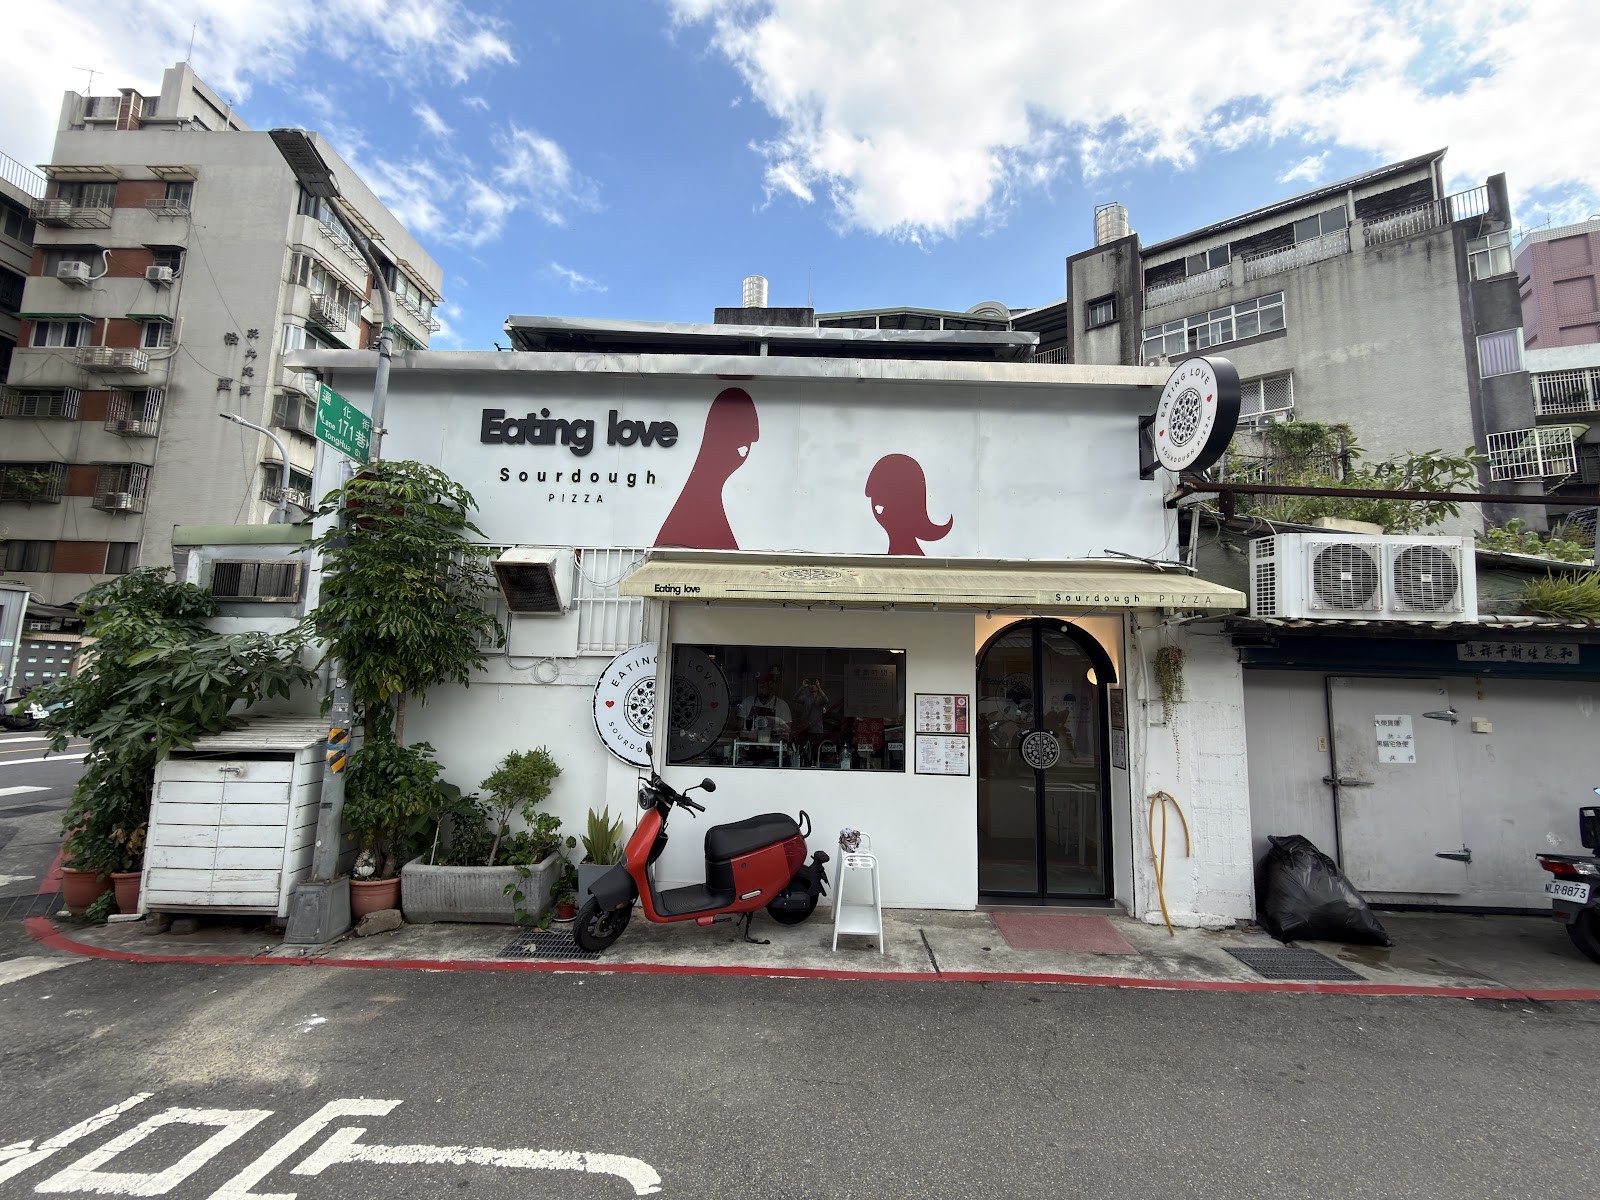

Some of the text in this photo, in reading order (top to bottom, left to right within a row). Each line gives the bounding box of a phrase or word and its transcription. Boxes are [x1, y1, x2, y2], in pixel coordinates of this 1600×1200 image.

[1160, 368, 1210, 418] EATING LOVE
[322, 389, 370, 432] 通化街
[321, 415, 336, 431] Lane
[480, 408, 679, 457] Eating love
[324, 429, 351, 452] TongHua
[1162, 415, 1211, 463] SOURDOUGH PIZZA
[499, 467, 656, 488] Sourdough
[548, 494, 604, 503] PIZZA
[654, 583, 701, 595] Eating love
[1055, 593, 1212, 605] Sourdough PIZZA
[688, 660, 717, 689] LOVE
